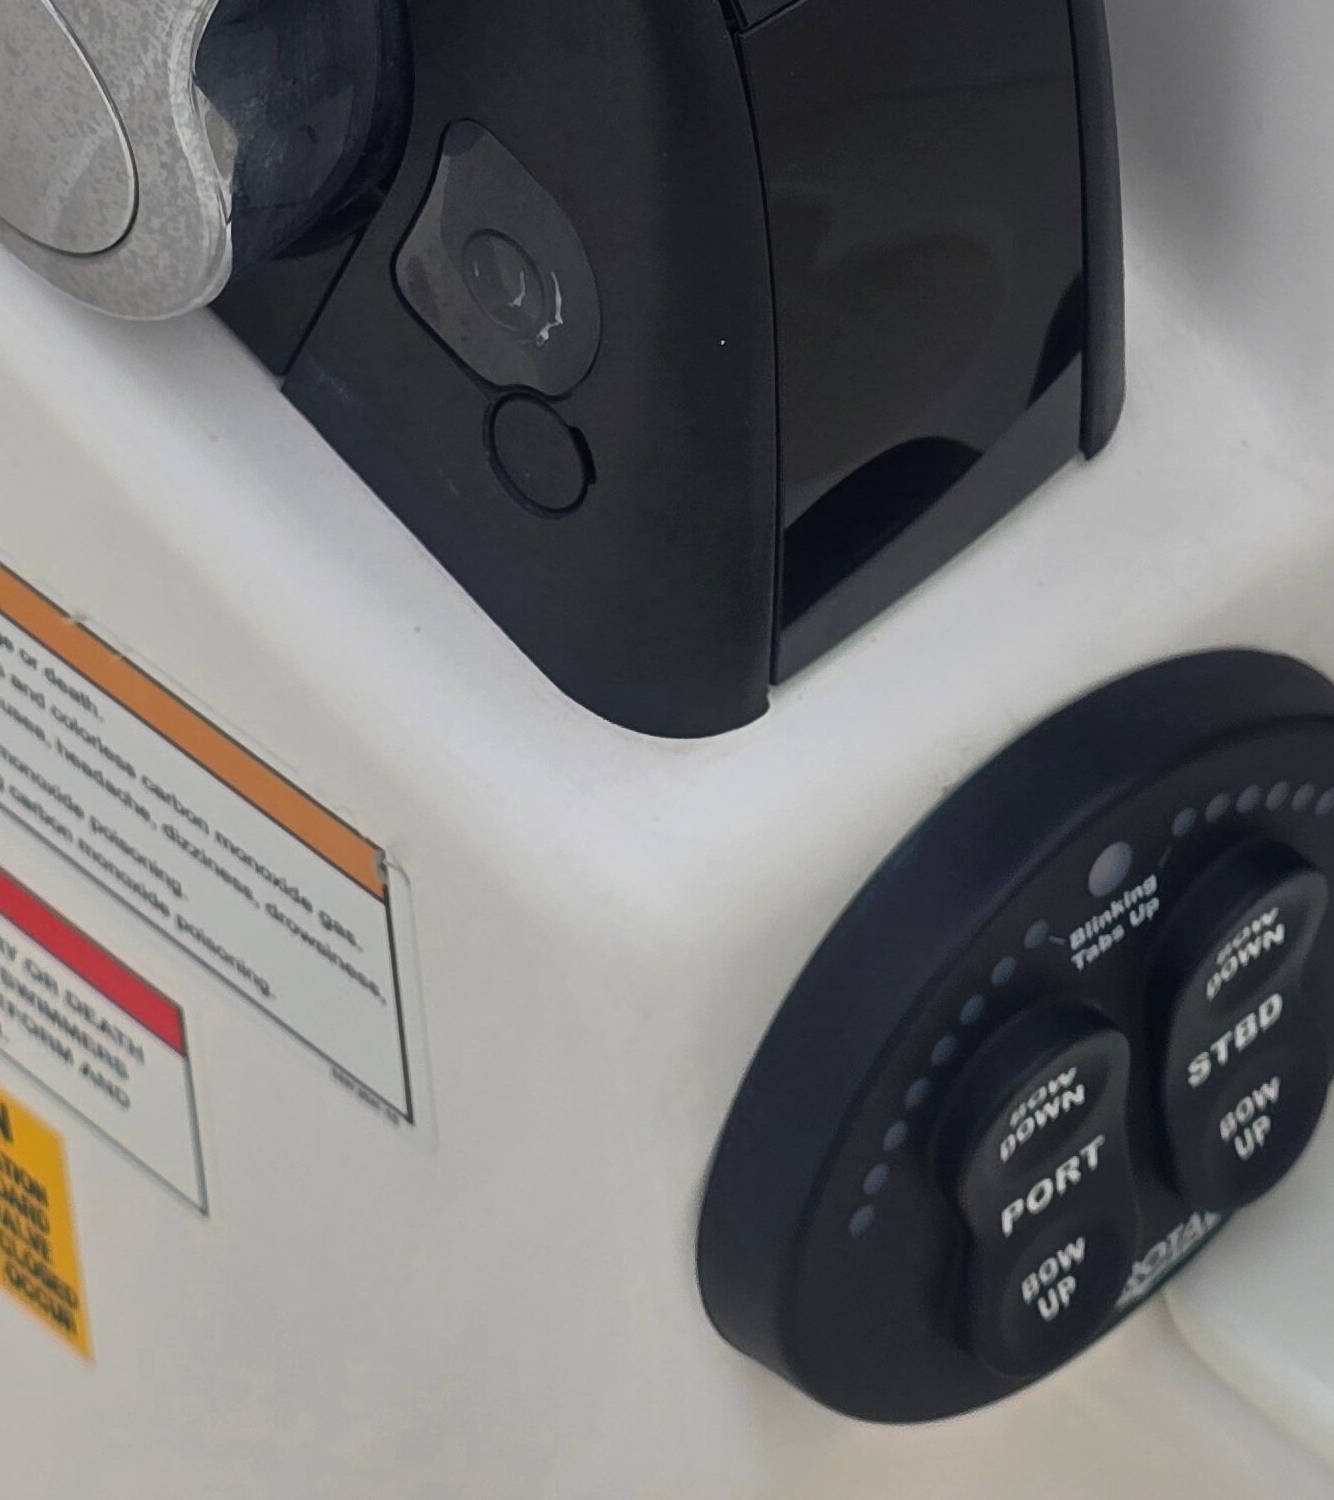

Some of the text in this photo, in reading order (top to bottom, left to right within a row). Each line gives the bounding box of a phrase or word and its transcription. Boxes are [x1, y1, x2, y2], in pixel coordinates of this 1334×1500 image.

[18, 645, 37, 673] or
[42, 660, 105, 725] death.
[9, 667, 46, 711] and
[49, 698, 137, 781] colorless
[140, 767, 210, 838] carbon
[213, 821, 313, 918] monoxide
[316, 904, 364, 959] gas.
[8, 778, 74, 845] carbon
[77, 830, 172, 922] monoxide
[174, 907, 276, 1005] poisoning.
[56, 734, 157, 832] headache,
[161, 815, 260, 912] dizziness,
[263, 893, 387, 1008] drowsiness,
[87, 807, 188, 909] poisoning.
[1069, 874, 1158, 951] Blinking
[1070, 897, 1160, 972] Tabs Up
[1205, 923, 1285, 1002] DOWN
[22, 952, 61, 1001] OR
[62, 982, 146, 1069] DEATH
[1187, 993, 1283, 1089] STBD
[74, 1050, 133, 1114] AND
[1219, 1076, 1281, 1142] BOW
[999, 1083, 1085, 1163] DOWN
[1234, 1115, 1272, 1160] UP
[1000, 1134, 1106, 1238] PORT
[1021, 1237, 1086, 1305] BOW
[1037, 1275, 1077, 1322] UP
